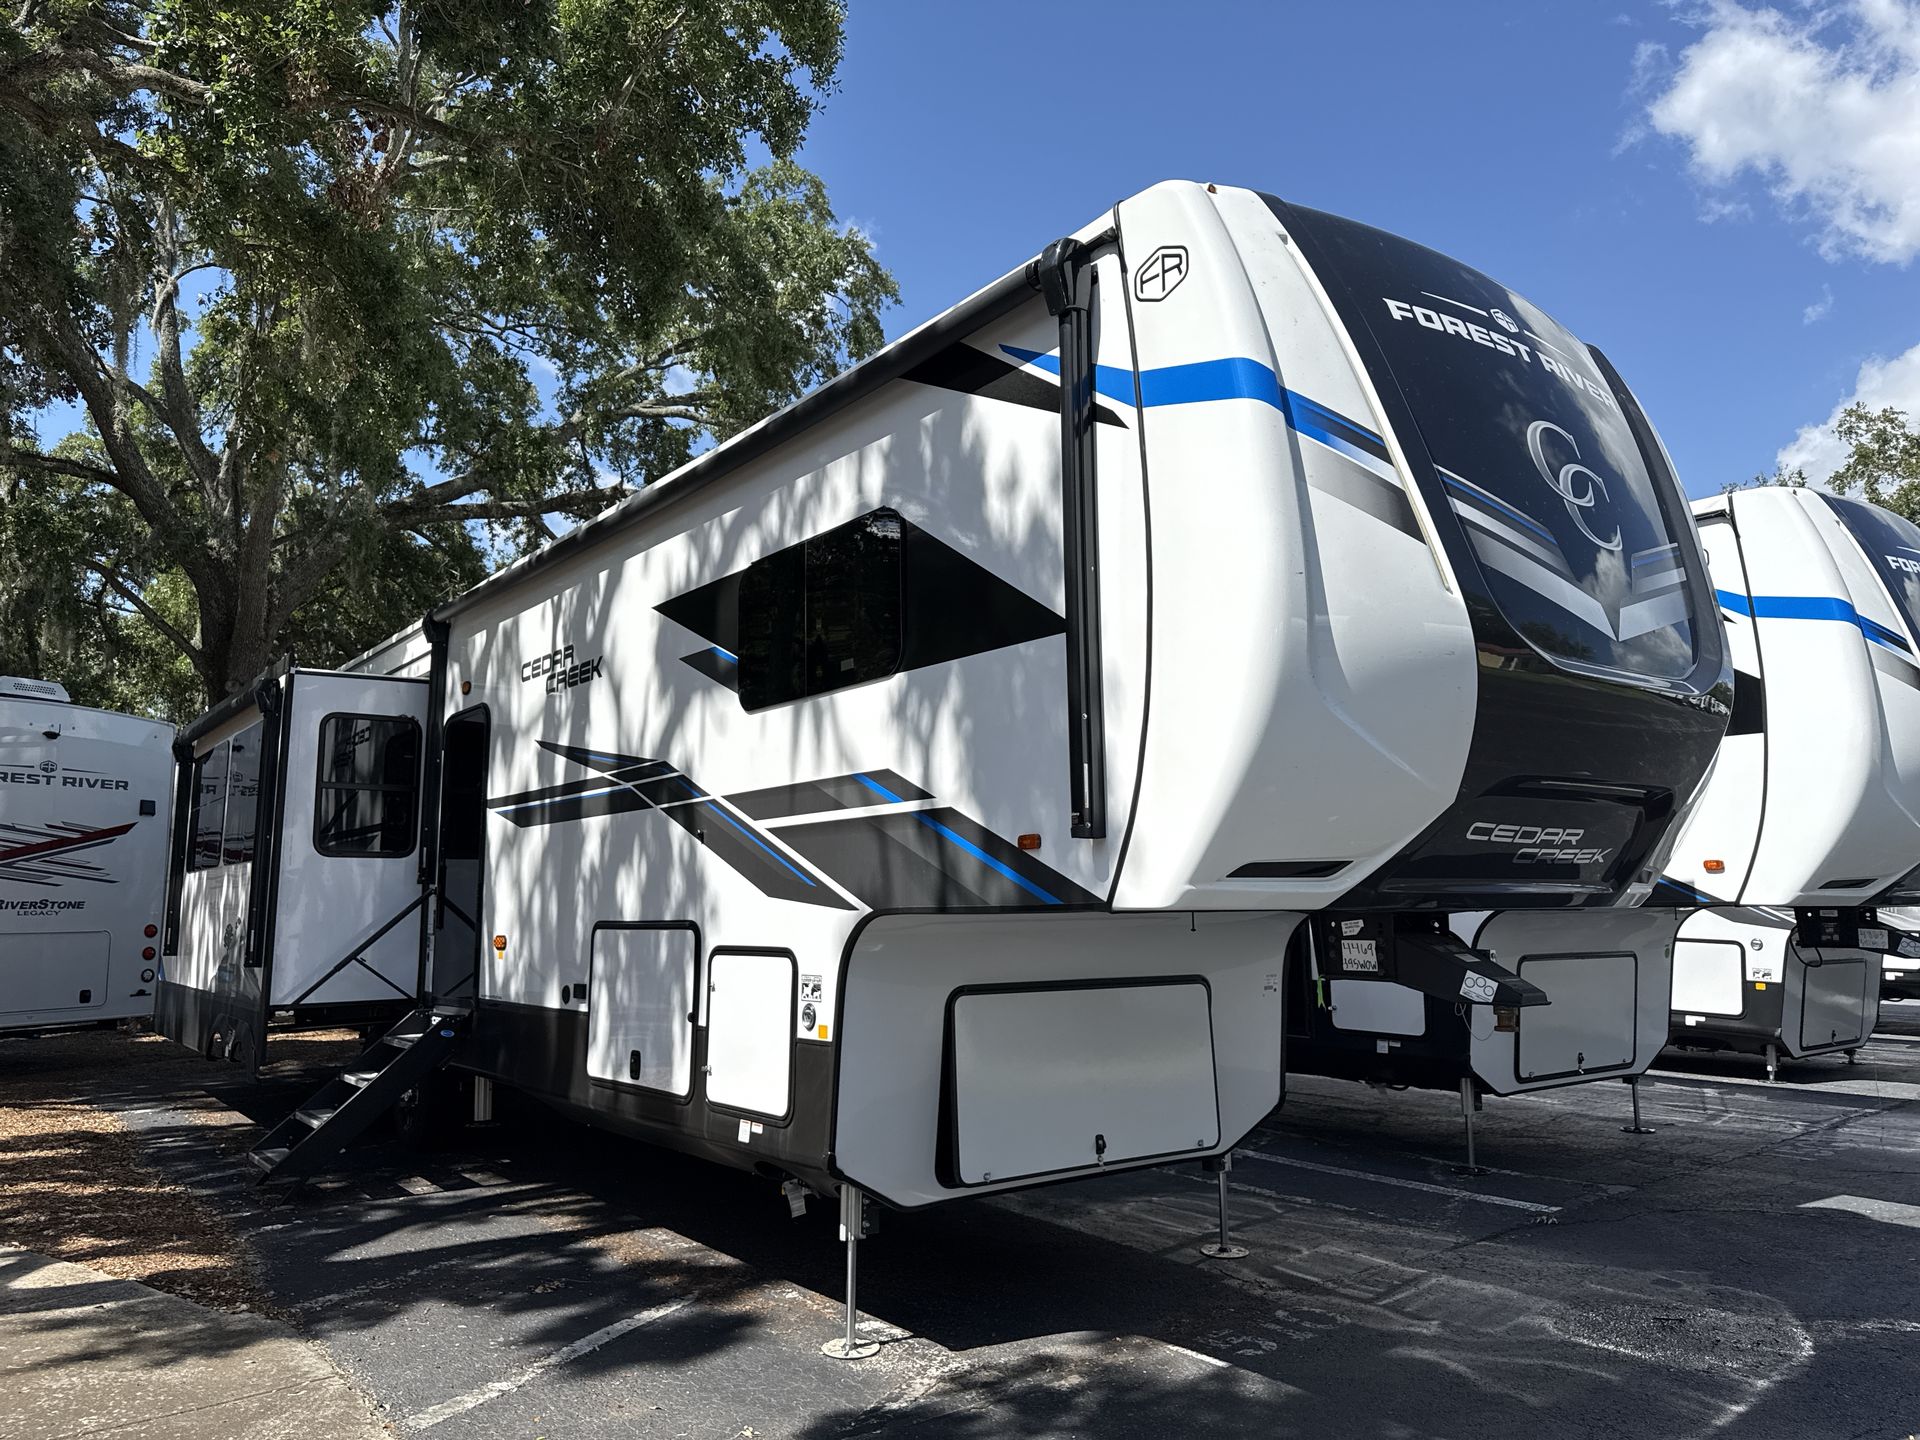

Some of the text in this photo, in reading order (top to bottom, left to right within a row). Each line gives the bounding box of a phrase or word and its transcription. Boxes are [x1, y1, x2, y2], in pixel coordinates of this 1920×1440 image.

[1382, 297, 1619, 413] FOREST RIVER
[521, 644, 574, 682] CEDAR
[546, 655, 603, 695] CREEK
[61, 776, 129, 791] RIVER
[1466, 821, 1585, 845] CEDAR
[1512, 847, 1613, 864] CREEK
[1342, 942, 1374, 956] 4469
